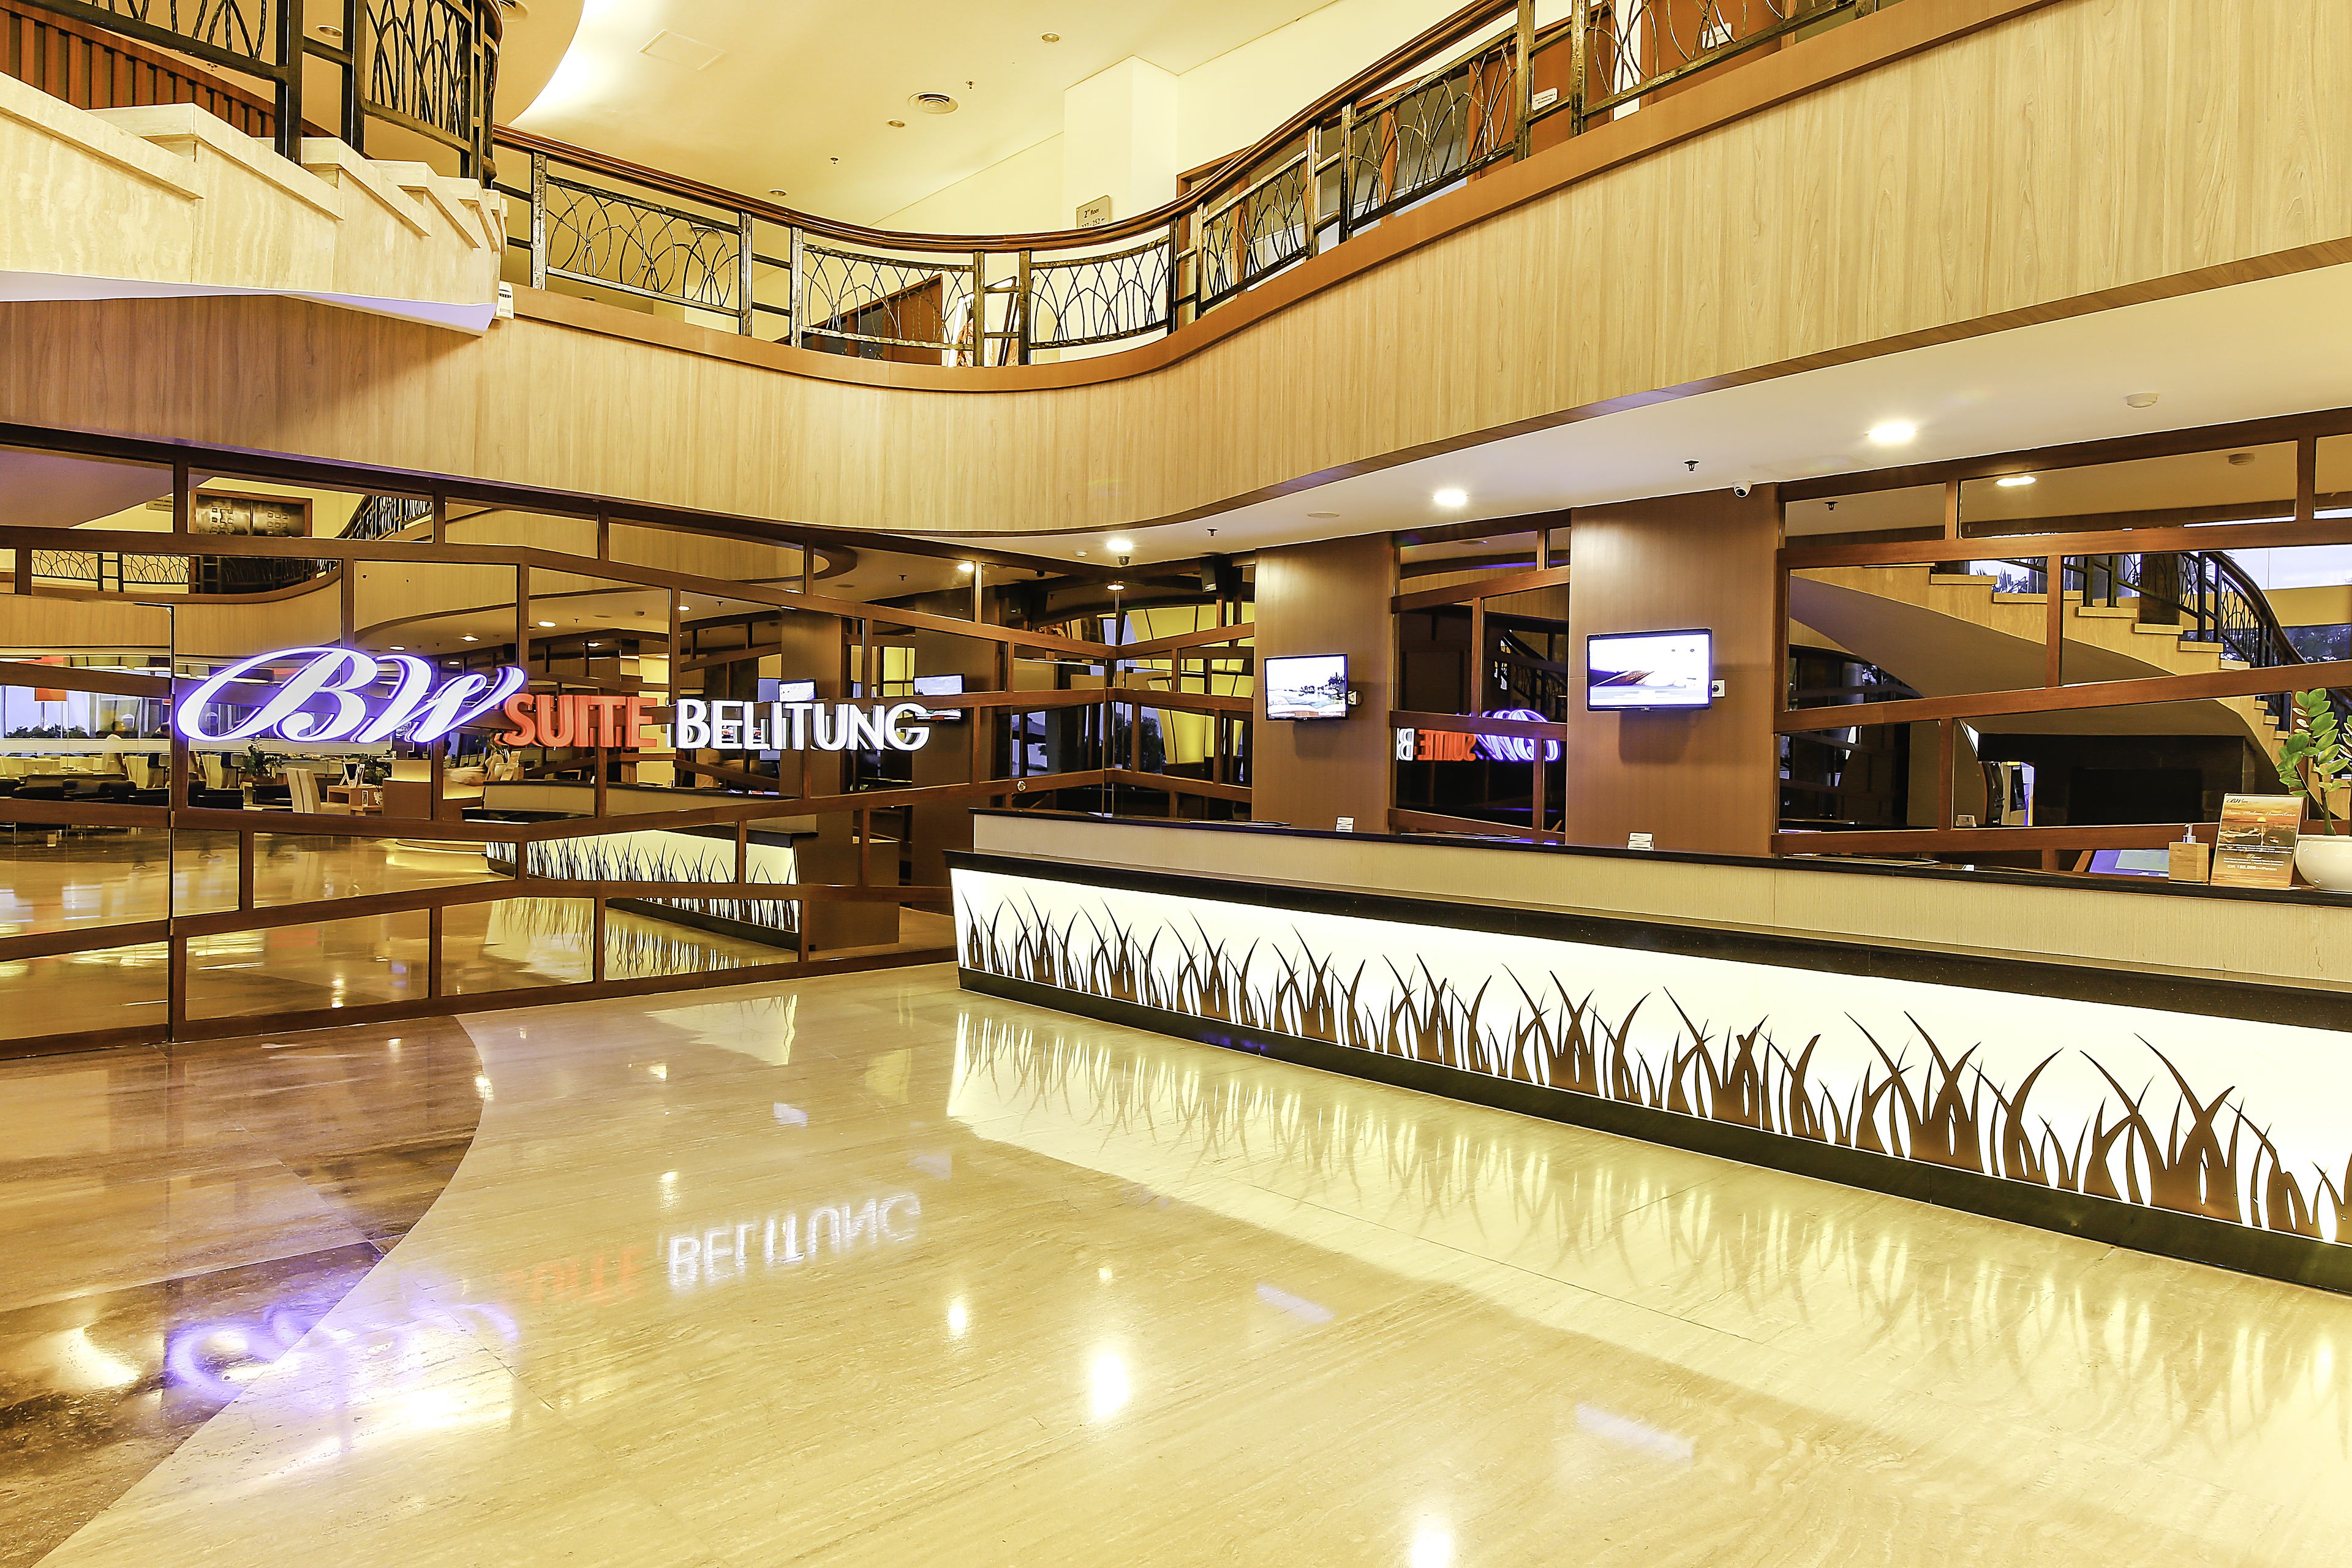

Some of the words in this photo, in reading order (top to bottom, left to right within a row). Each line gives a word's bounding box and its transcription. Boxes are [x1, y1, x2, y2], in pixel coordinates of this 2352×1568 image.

[177, 646, 525, 743] BW
[503, 693, 658, 748] SUITE
[676, 698, 930, 751] BELITUNG
